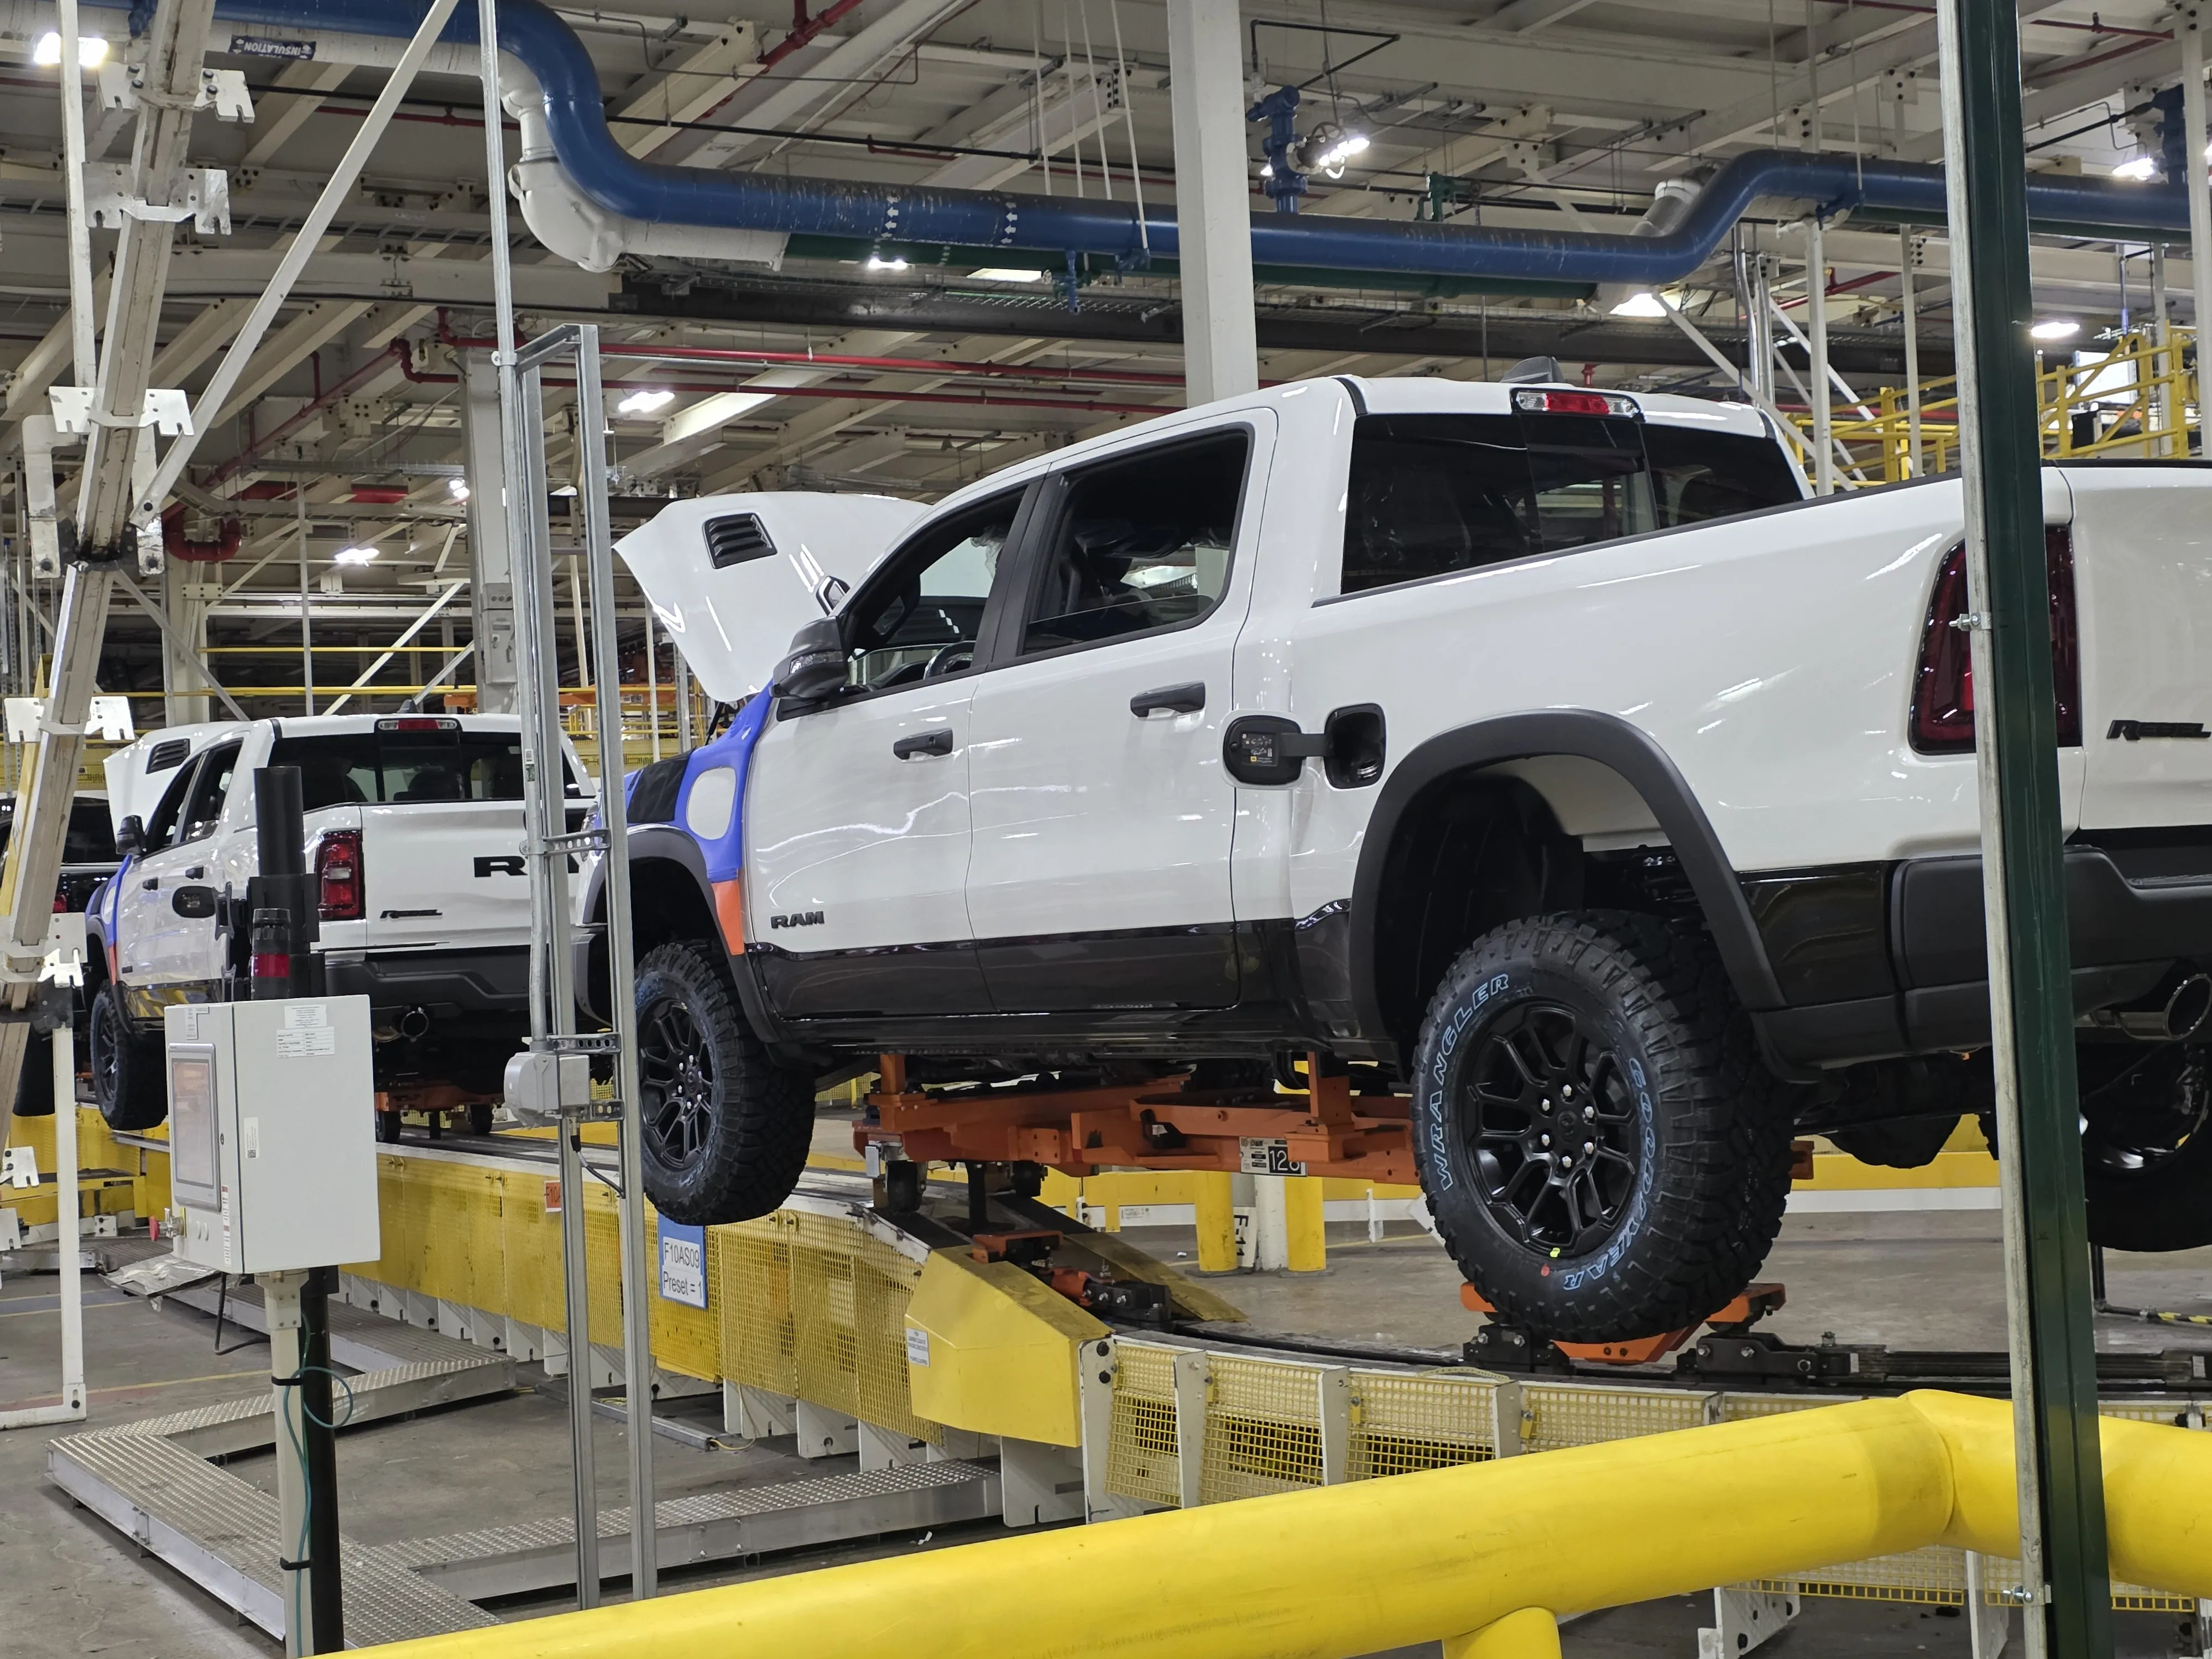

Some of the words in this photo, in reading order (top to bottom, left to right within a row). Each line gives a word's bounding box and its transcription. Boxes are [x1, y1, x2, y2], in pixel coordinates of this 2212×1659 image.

[243, 41, 301, 56] INSULATION
[2106, 719, 2211, 741] REBEL
[770, 911, 825, 929] RAM
[1430, 973, 1509, 1191] WRANGLER
[1563, 1057, 1656, 1290] GOODYEAR
[664, 1242, 700, 1269] F10AS09
[663, 1271, 689, 1296] Preset
[690, 1283, 696, 1292] =
[698, 1280, 702, 1299] 1
